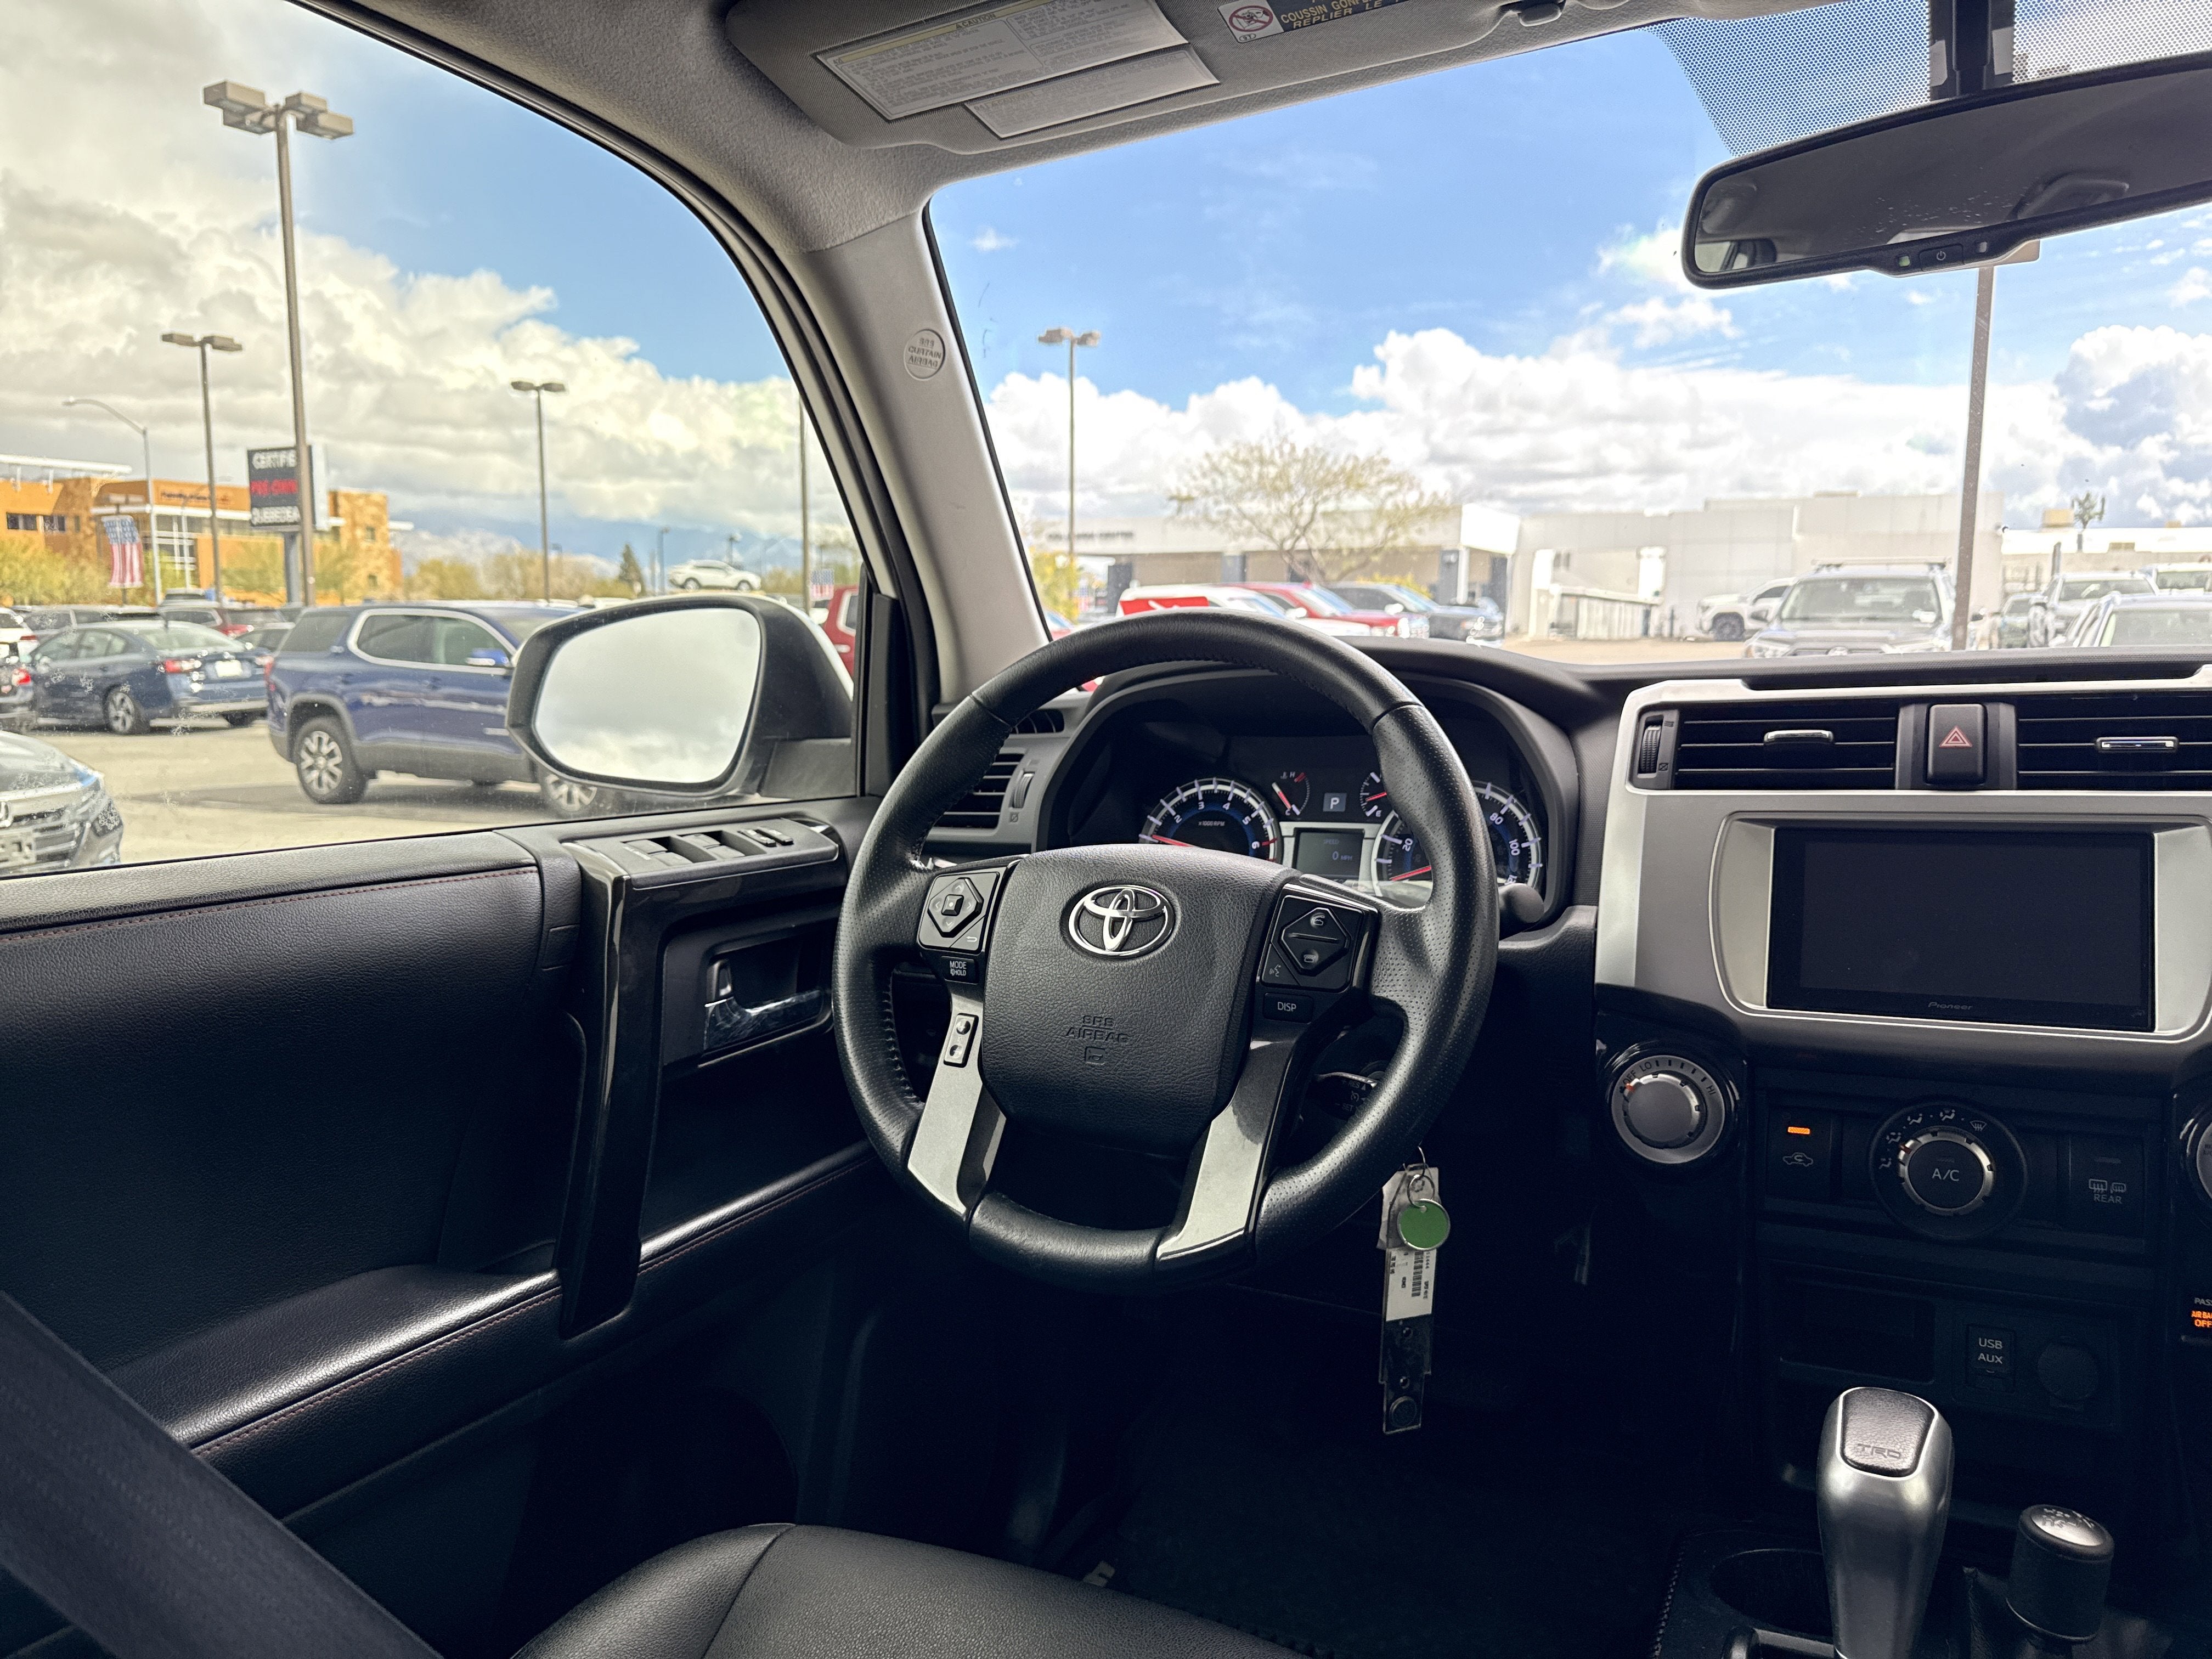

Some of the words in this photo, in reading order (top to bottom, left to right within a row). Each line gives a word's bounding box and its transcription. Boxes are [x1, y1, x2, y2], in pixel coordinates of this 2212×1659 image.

[1280, 4, 1328, 23] COUSSIN
[1293, 8, 1352, 29] REPLIER
[962, 13, 997, 27] CAUTION
[908, 346, 941, 359] CURTAIN
[1198, 802, 1205, 810] 3
[1222, 802, 1231, 810] 4
[1330, 797, 1340, 809] P
[1173, 814, 1182, 823] 2
[1242, 816, 1251, 825] 5
[1489, 812, 1504, 825] 80
[1251, 841, 1260, 849] 6
[1402, 838, 1413, 851] 20
[1509, 839, 1520, 855] 100
[1332, 851, 1339, 860] 0
[950, 961, 967, 969] MODE
[1277, 1001, 1296, 1012] DISP
[1928, 1002, 1973, 1011] Pioneer
[1082, 1015, 1115, 1027] SRS
[1066, 1027, 1131, 1043] AIRBAG
[1639, 1062, 1652, 1072] LO
[1706, 1085, 1717, 1095] HI
[1932, 1168, 1960, 1182] A/C
[2094, 1193, 2123, 1204] REAR
[1979, 1337, 2003, 1349] USB
[1978, 1352, 2003, 1364] AUX
[1858, 1443, 1901, 1460] TRD
